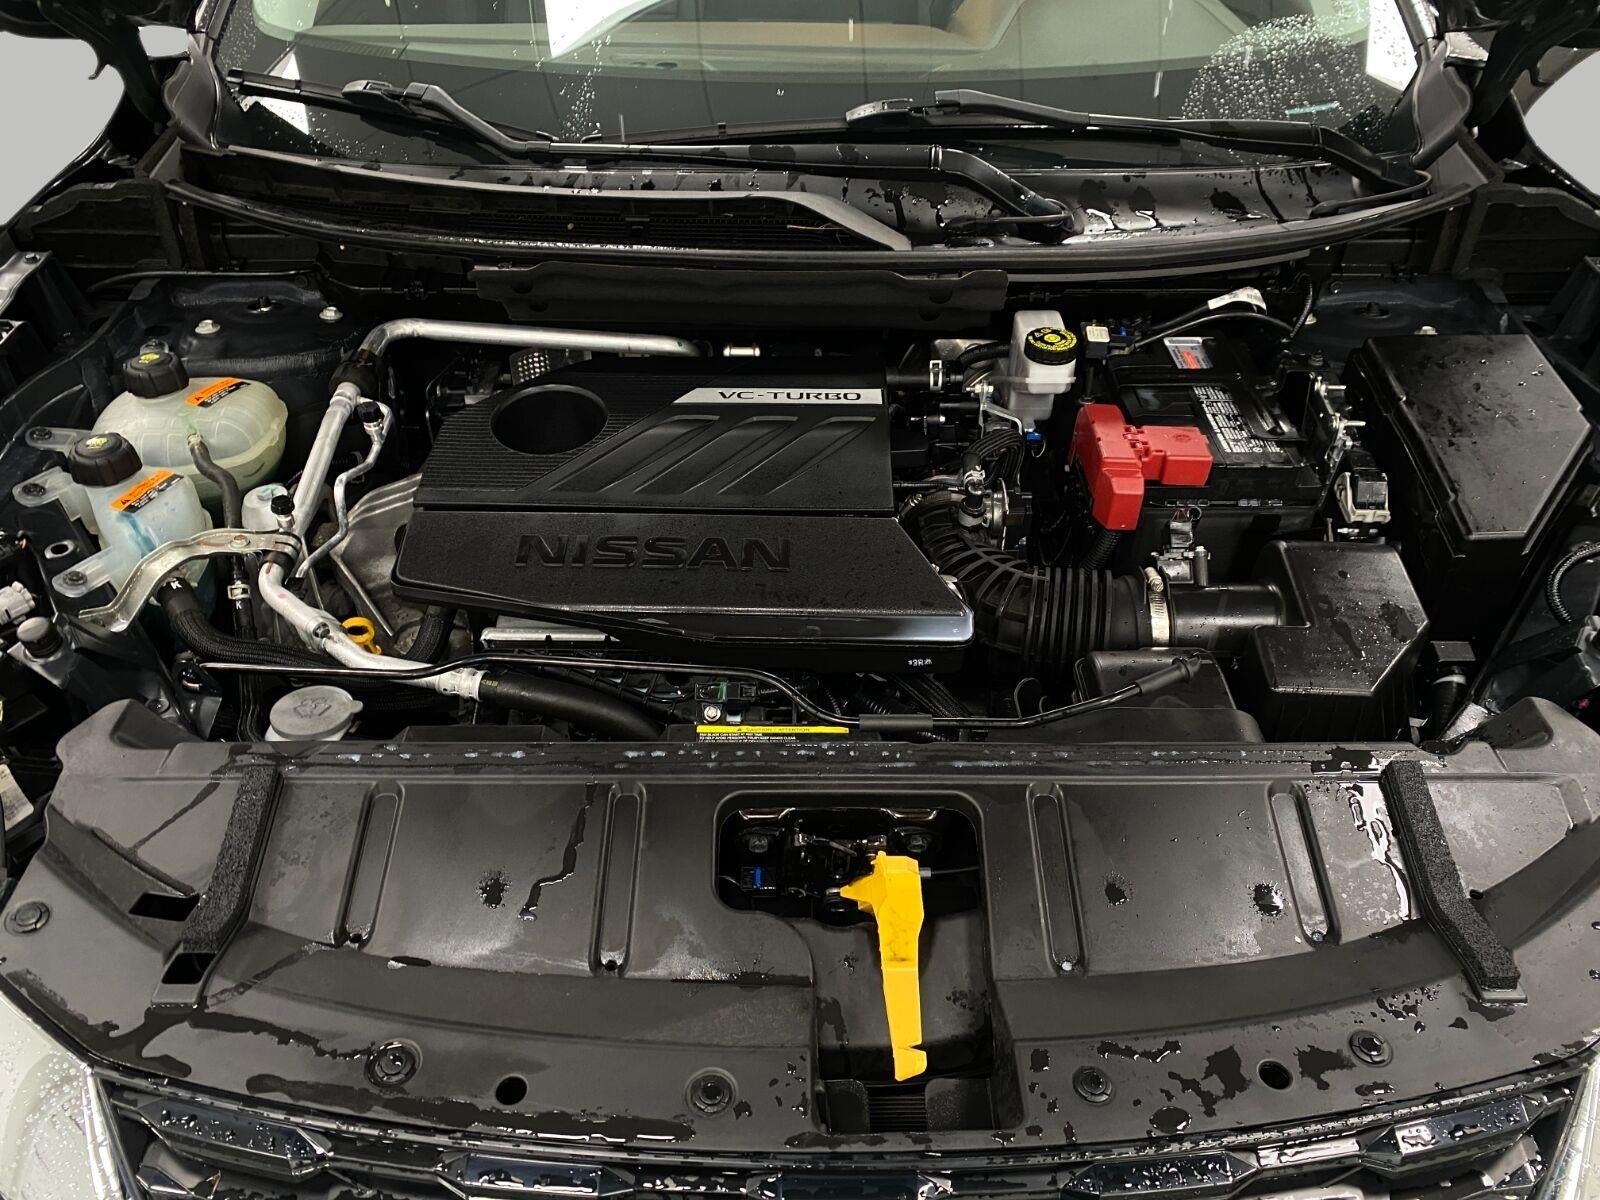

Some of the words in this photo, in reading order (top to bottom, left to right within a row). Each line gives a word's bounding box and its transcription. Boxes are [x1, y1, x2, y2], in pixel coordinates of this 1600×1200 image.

[718, 391, 862, 401] VC-TURBO
[514, 535, 792, 571] NISSAN
[236, 601, 242, 610] K
